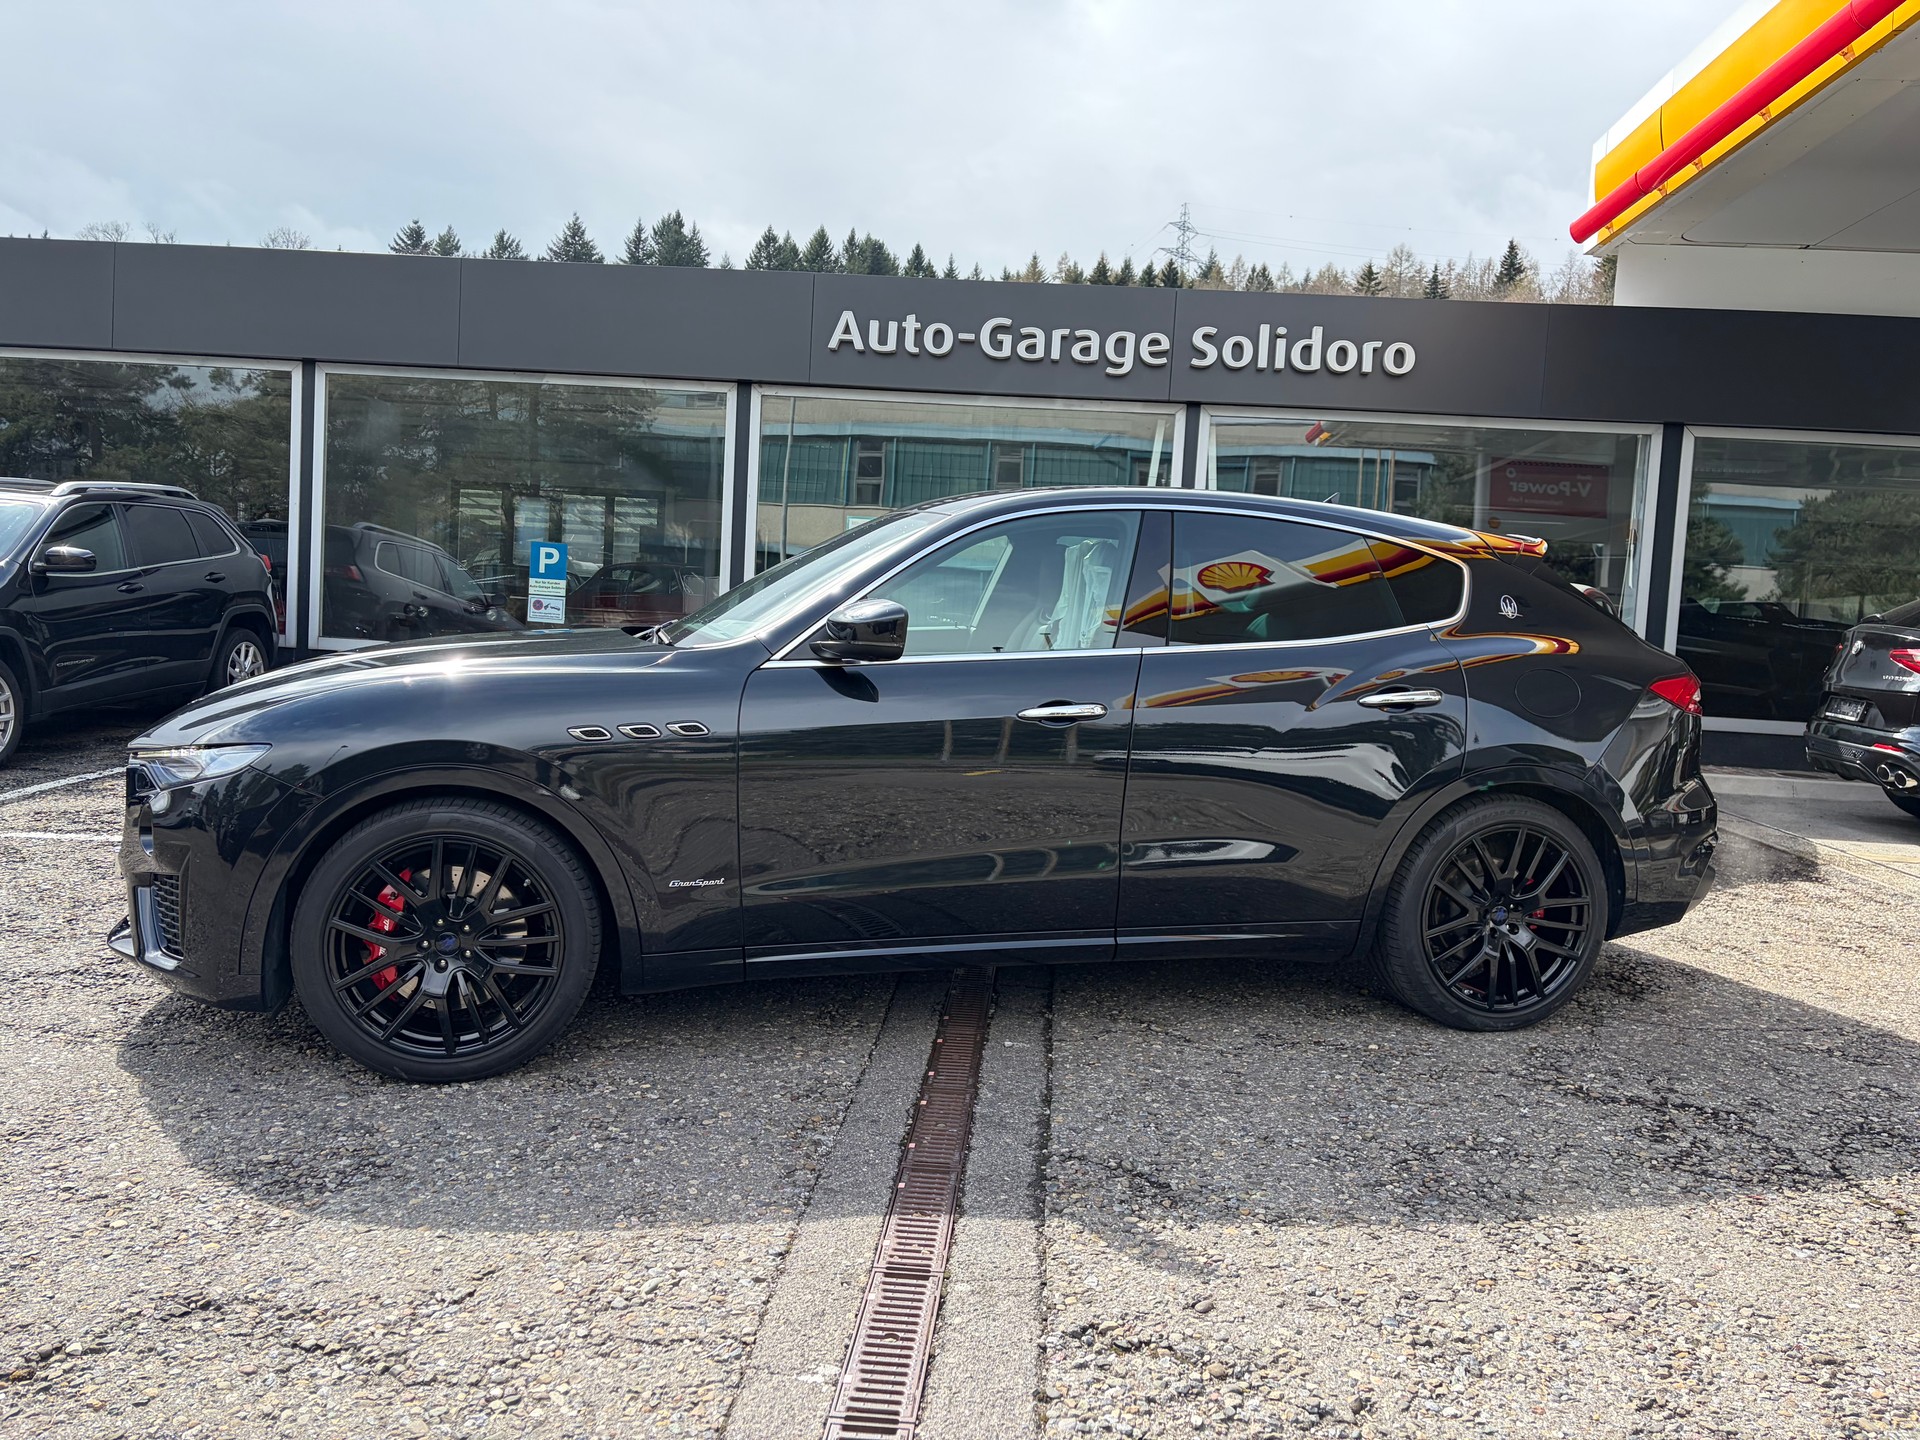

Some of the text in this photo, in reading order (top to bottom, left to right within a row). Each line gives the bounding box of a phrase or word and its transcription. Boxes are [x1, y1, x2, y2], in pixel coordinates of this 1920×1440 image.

[828, 310, 1416, 376] Auto-Garage Solidoro
[538, 547, 560, 573] P
[669, 877, 725, 887] GranSport
